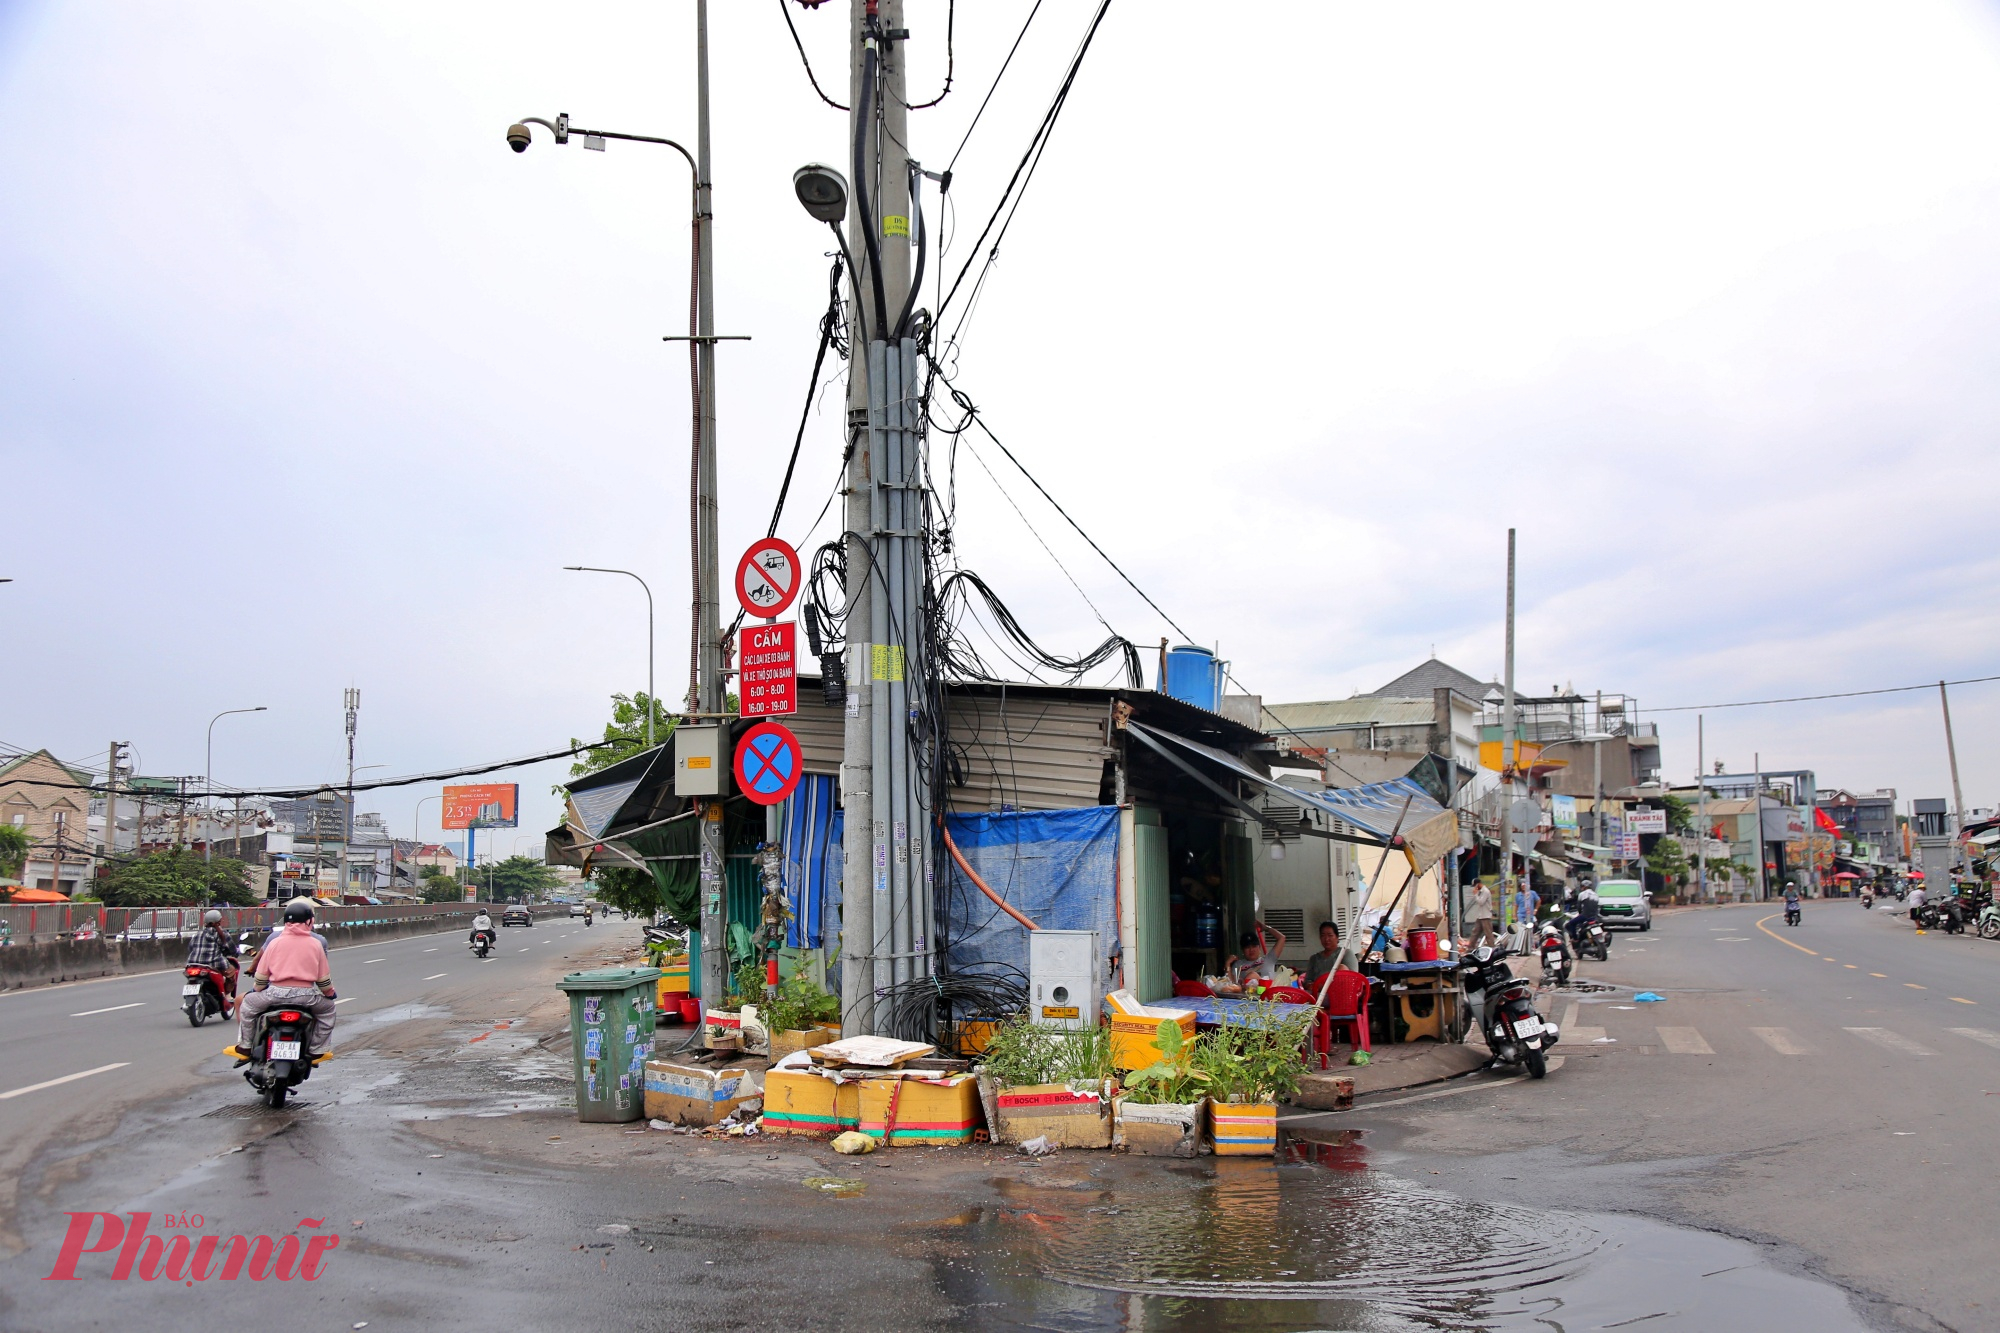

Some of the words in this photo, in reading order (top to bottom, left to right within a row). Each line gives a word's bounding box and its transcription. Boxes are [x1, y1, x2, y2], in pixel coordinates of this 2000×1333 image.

[753, 626, 782, 648] CẤM
[744, 652, 754, 666] CÁC
[754, 653, 765, 667] LOẠI
[765, 653, 771, 664] XE
[771, 652, 777, 663] 03
[777, 649, 791, 662] BÁNH
[749, 671, 756, 682] XE
[773, 668, 779, 679] 04
[779, 665, 793, 678] BÁNH
[750, 686, 765, 697] 6:00
[770, 684, 785, 695] 8:00
[748, 702, 765, 714] 16:00
[771, 700, 788, 712] 19:00
[1014, 1096, 1040, 1105] BOSCH
[1054, 1095, 1080, 1103] BOSCH
